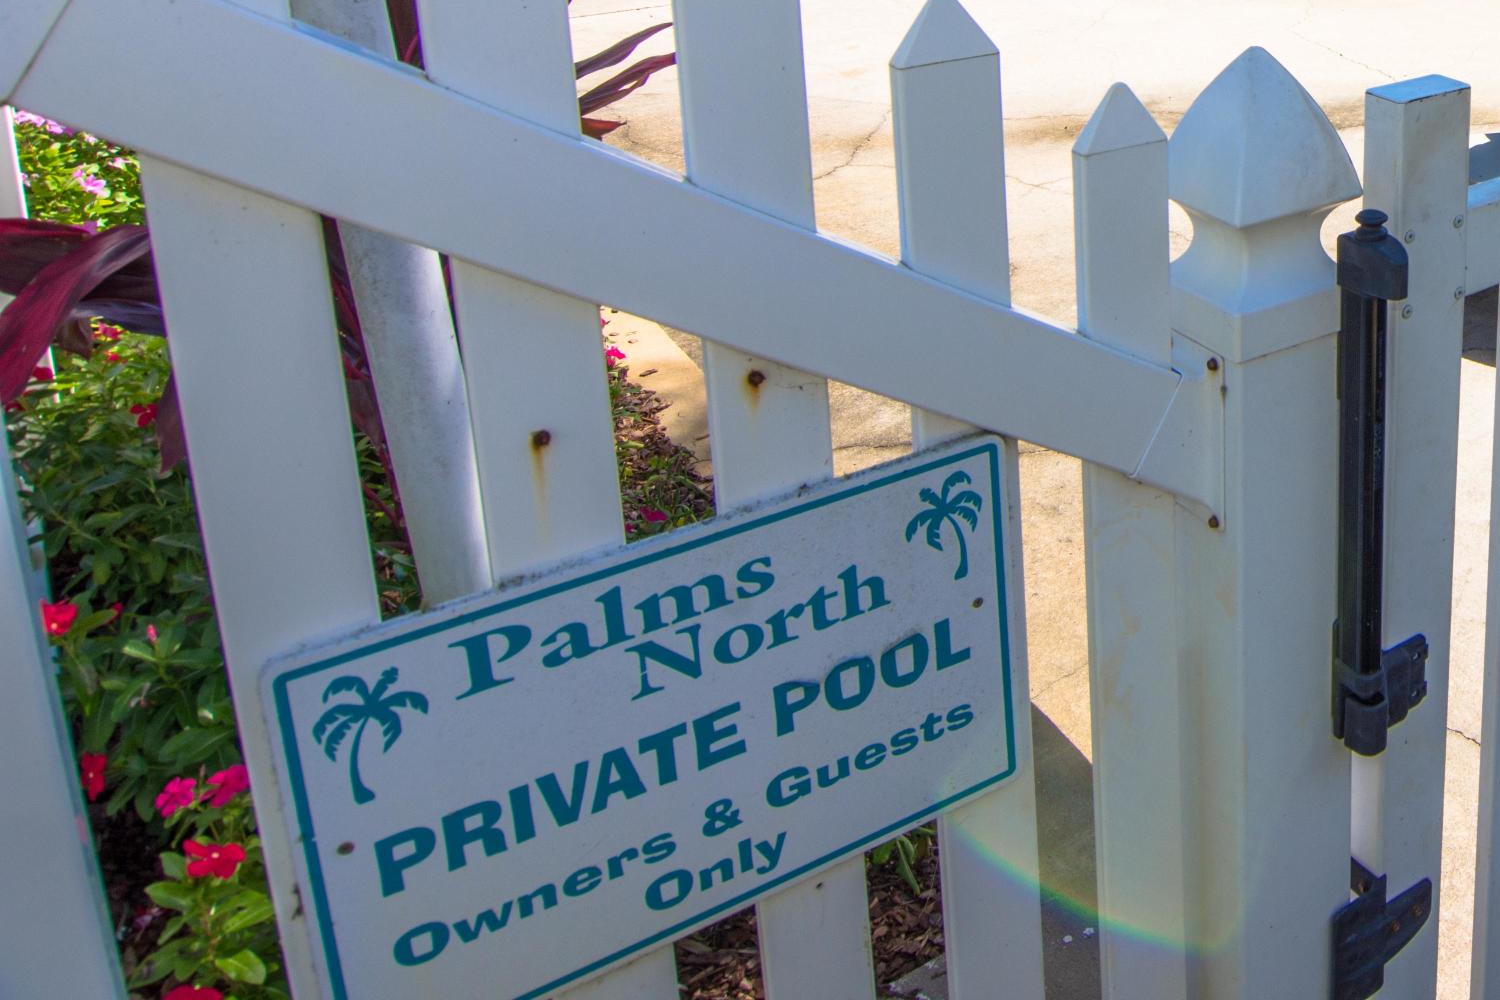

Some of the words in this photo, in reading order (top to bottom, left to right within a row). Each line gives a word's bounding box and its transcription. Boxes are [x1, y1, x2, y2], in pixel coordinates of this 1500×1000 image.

[447, 556, 776, 700] Palms
[623, 564, 890, 700] North
[374, 702, 746, 898] PRIVATE
[772, 617, 971, 737] POOL
[394, 832, 676, 967] Owners
[701, 797, 743, 838] &
[765, 703, 974, 808] Guests
[645, 831, 788, 911] Only
